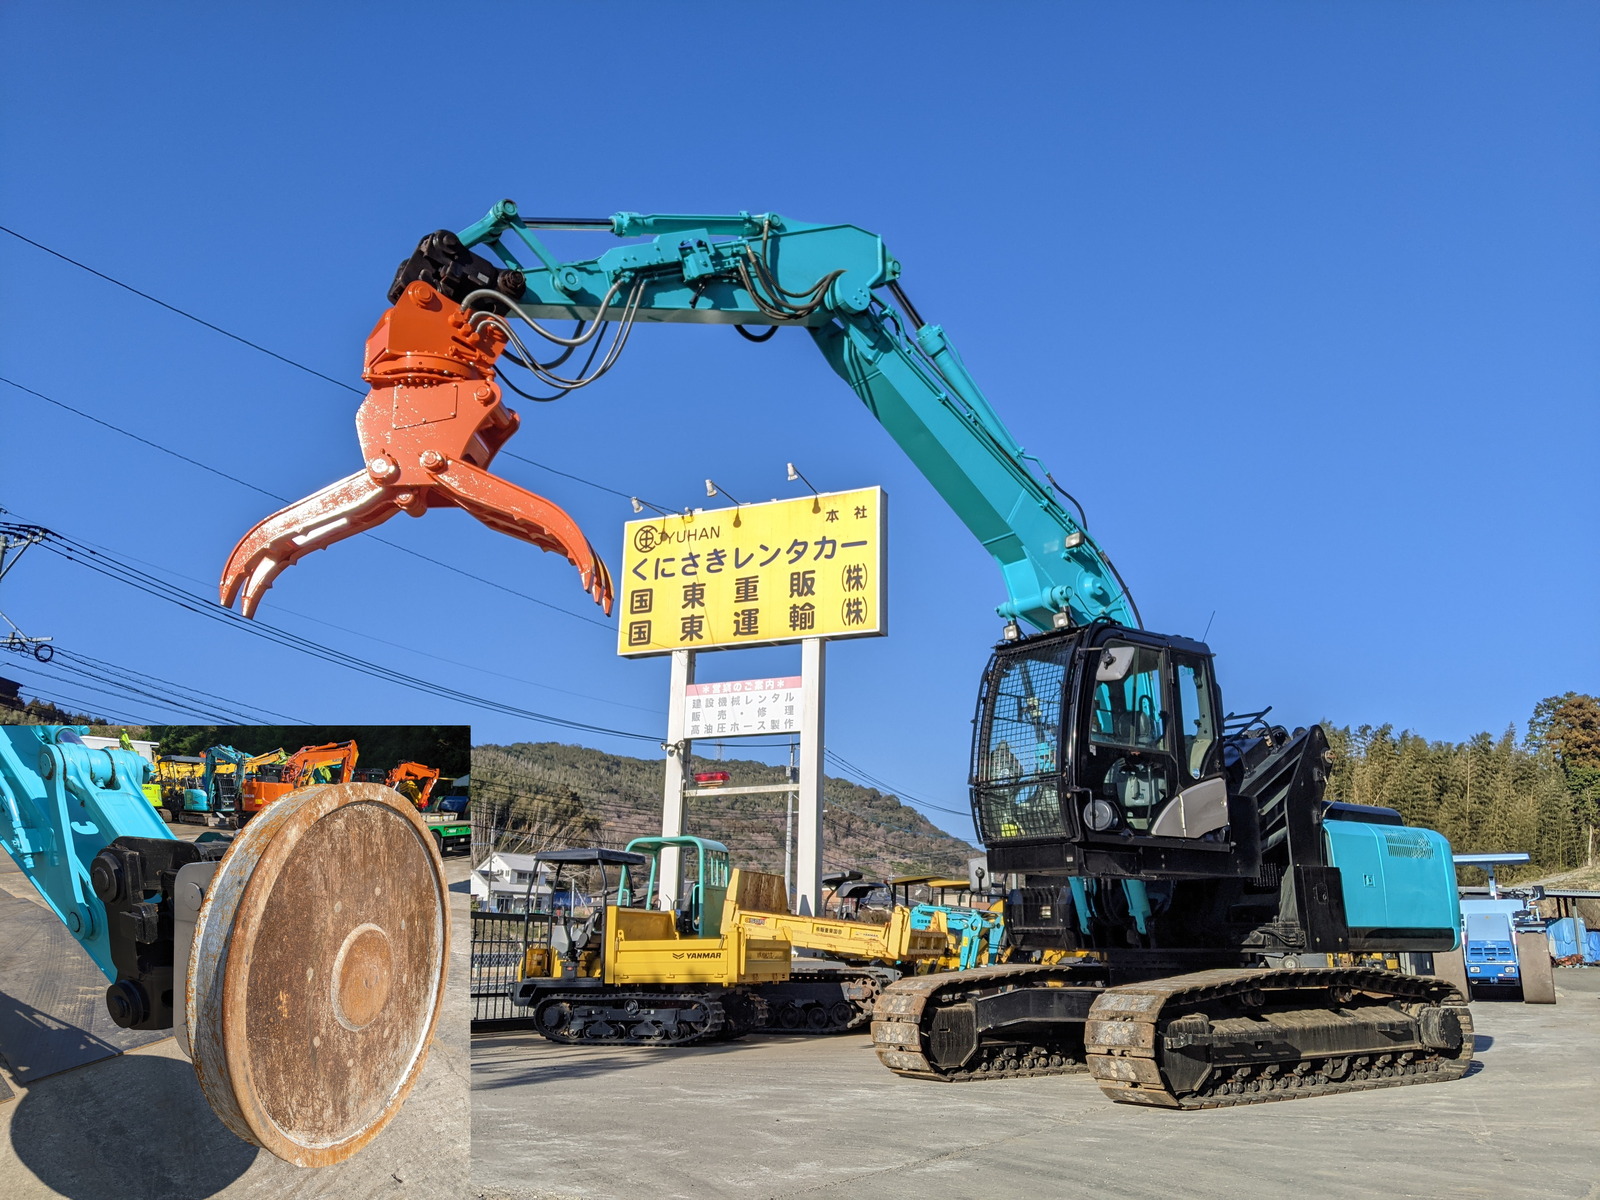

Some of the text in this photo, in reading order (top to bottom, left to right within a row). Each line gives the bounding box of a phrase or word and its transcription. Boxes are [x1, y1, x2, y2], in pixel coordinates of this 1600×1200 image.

[825, 505, 868, 523] 本社
[654, 526, 720, 546] JYUHAN
[632, 535, 868, 581] くにさきレンタカー
[692, 692, 795, 709] 建設機械レンタル
[691, 719, 794, 735] 高油圧ホース製作
[686, 952, 722, 960] YANMAR
